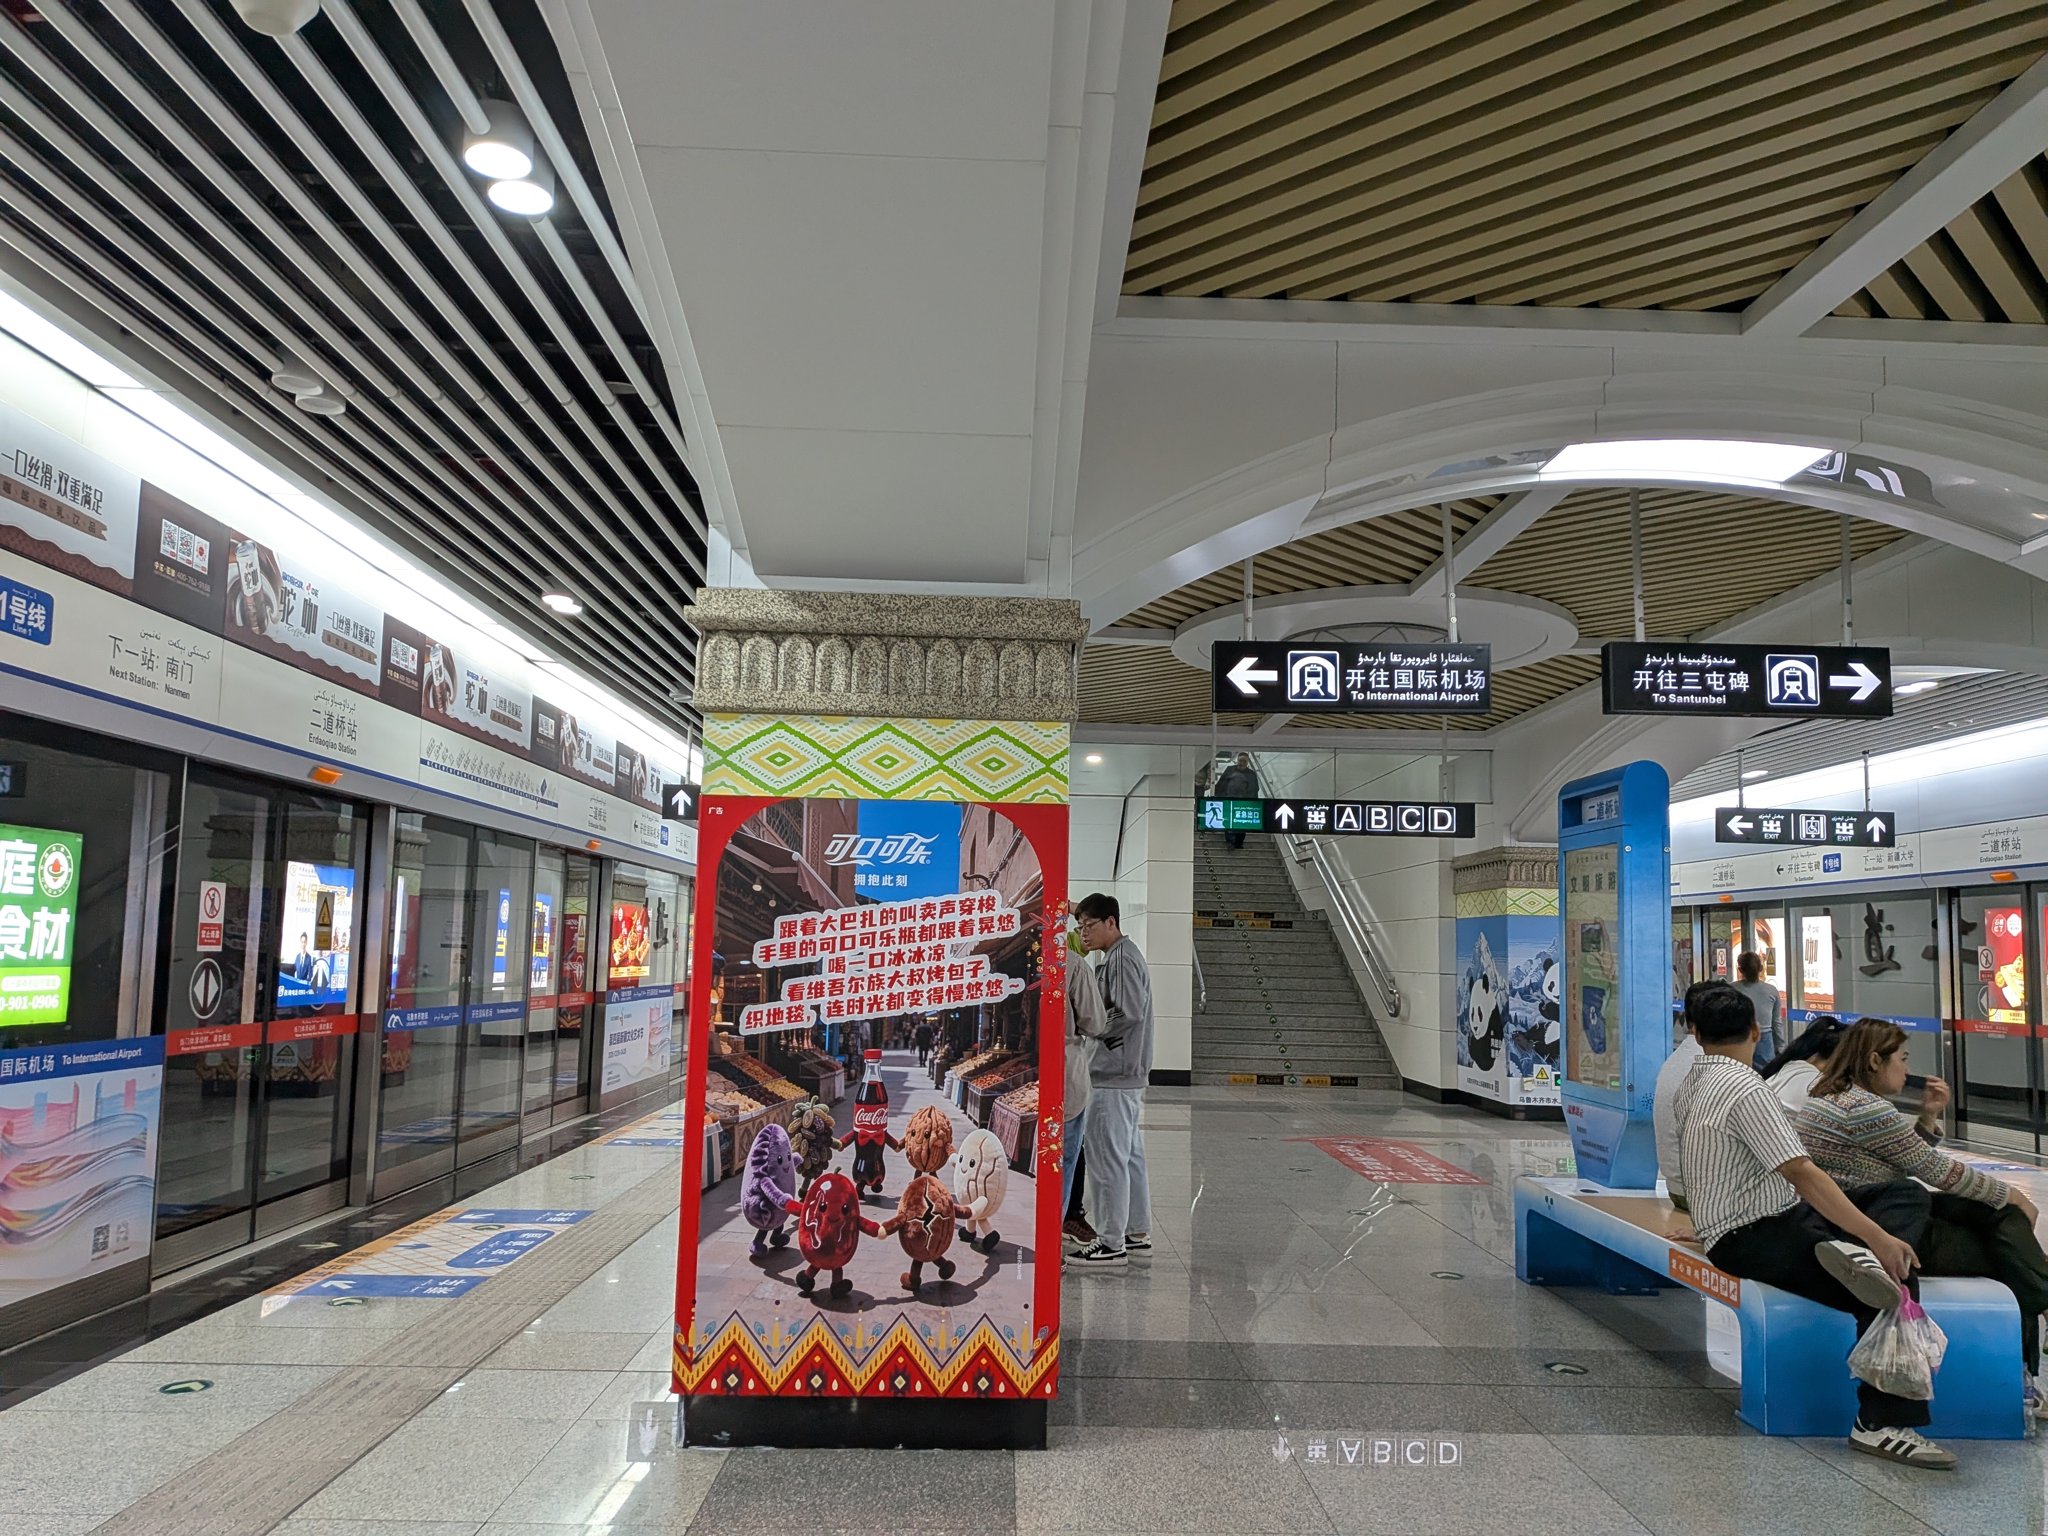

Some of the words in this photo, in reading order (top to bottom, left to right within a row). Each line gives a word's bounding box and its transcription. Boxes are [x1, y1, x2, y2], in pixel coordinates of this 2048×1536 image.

[0, 590, 46, 632] 1号线
[279, 586, 318, 635] 驼咖
[12, 623, 27, 635] Line
[28, 628, 32, 636] 1
[166, 656, 193, 684] 南门
[1345, 668, 1486, 690] 开往国际机场
[1633, 669, 1750, 692] 开往三屯碑
[110, 665, 128, 680] Next
[129, 672, 159, 690] Station:
[165, 683, 190, 700] Nanmen
[1351, 691, 1364, 700] To
[1367, 691, 1438, 701] International
[1439, 691, 1479, 702] Airport
[1652, 693, 1666, 703] To
[1669, 694, 1726, 704] Santunbei
[310, 708, 358, 741] 二道桥站
[308, 732, 337, 750] Erdaoqiao
[338, 742, 357, 756] Station
[708, 807, 723, 815] 广告
[1235, 810, 1259, 819] 紧急出口
[1339, 808, 1358, 828] A
[1371, 809, 1388, 828] B
[1402, 809, 1421, 829] C
[1433, 810, 1452, 829] D
[824, 832, 939, 867] 可口可乐
[1980, 836, 2021, 853] 二道桥站
[0, 839, 38, 895] 庭
[1788, 860, 1820, 874] 开往三屯碑
[1824, 857, 1840, 870] 1号线
[1887, 850, 1914, 862] 新疆大学
[854, 873, 908, 887] 拥抱此刻
[779, 894, 996, 938] 跟着大巴扎的叫卖声穿梭
[0, 904, 70, 961] 食材
[758, 914, 1016, 962] 手里的可口可乐瓶都跟着晃悠
[828, 944, 946, 974] 喝一口冰冰凉
[786, 960, 985, 1002] 看维吾尔族大叔烤包子
[1, 1055, 55, 1077] 国际机场
[62, 1055, 71, 1065] To
[73, 1050, 118, 1064] International
[118, 1047, 142, 1060] Airport
[1519, 1096, 1560, 1104] 乌鲁木齐市水
